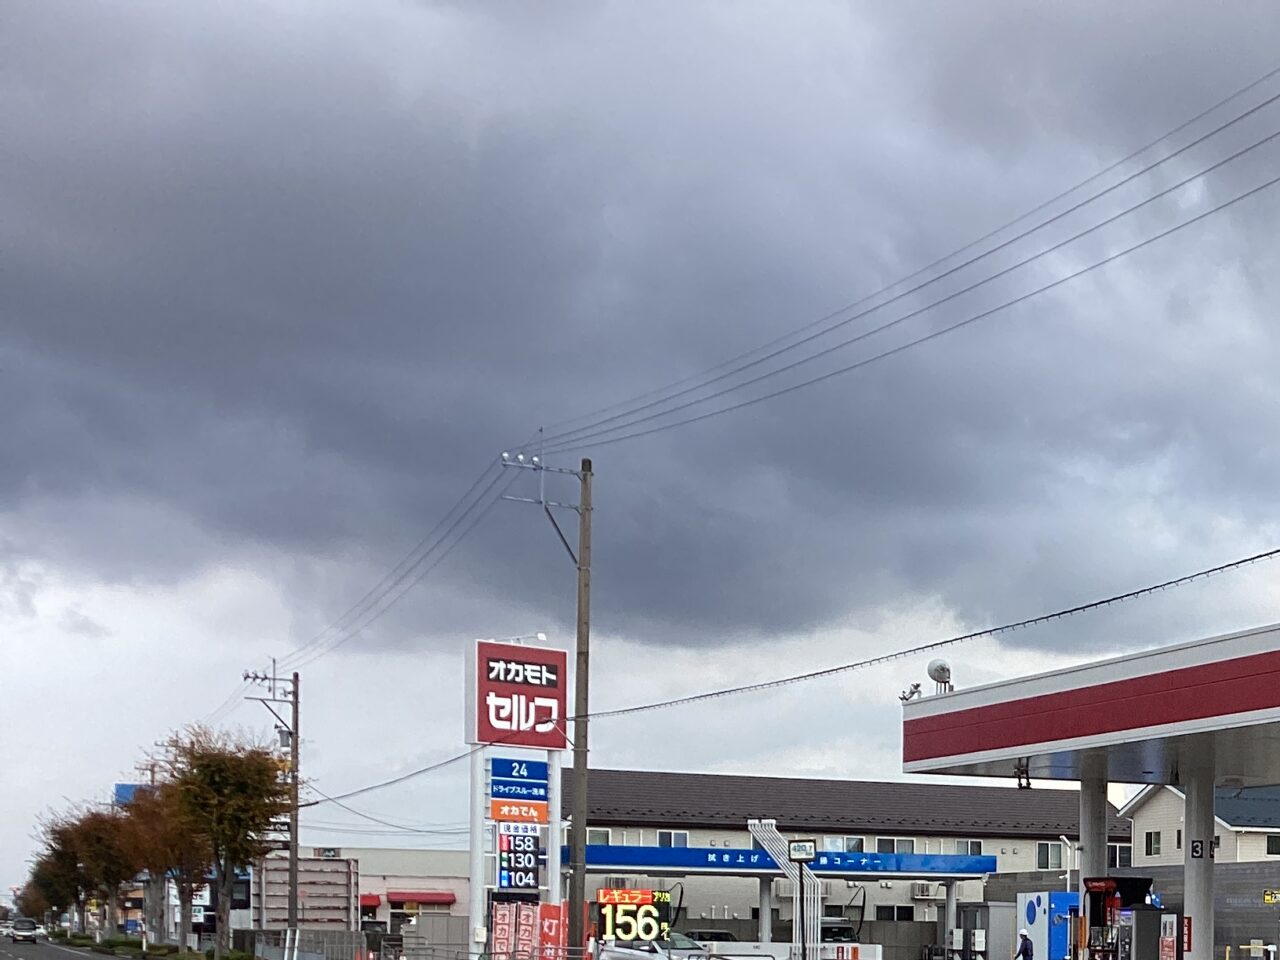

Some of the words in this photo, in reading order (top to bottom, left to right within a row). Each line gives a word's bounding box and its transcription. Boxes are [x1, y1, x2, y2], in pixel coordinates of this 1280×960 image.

[489, 660, 557, 686] オカモト
[486, 691, 559, 733] セルフ
[511, 762, 528, 777] 24
[500, 805, 538, 817] オカでん
[503, 824, 538, 834] 現金価格
[508, 836, 534, 851] 158
[1193, 841, 1202, 857] 3
[508, 853, 535, 868] 130
[508, 871, 536, 886] 104
[599, 889, 652, 903] レギュラー
[601, 903, 660, 941] 156
